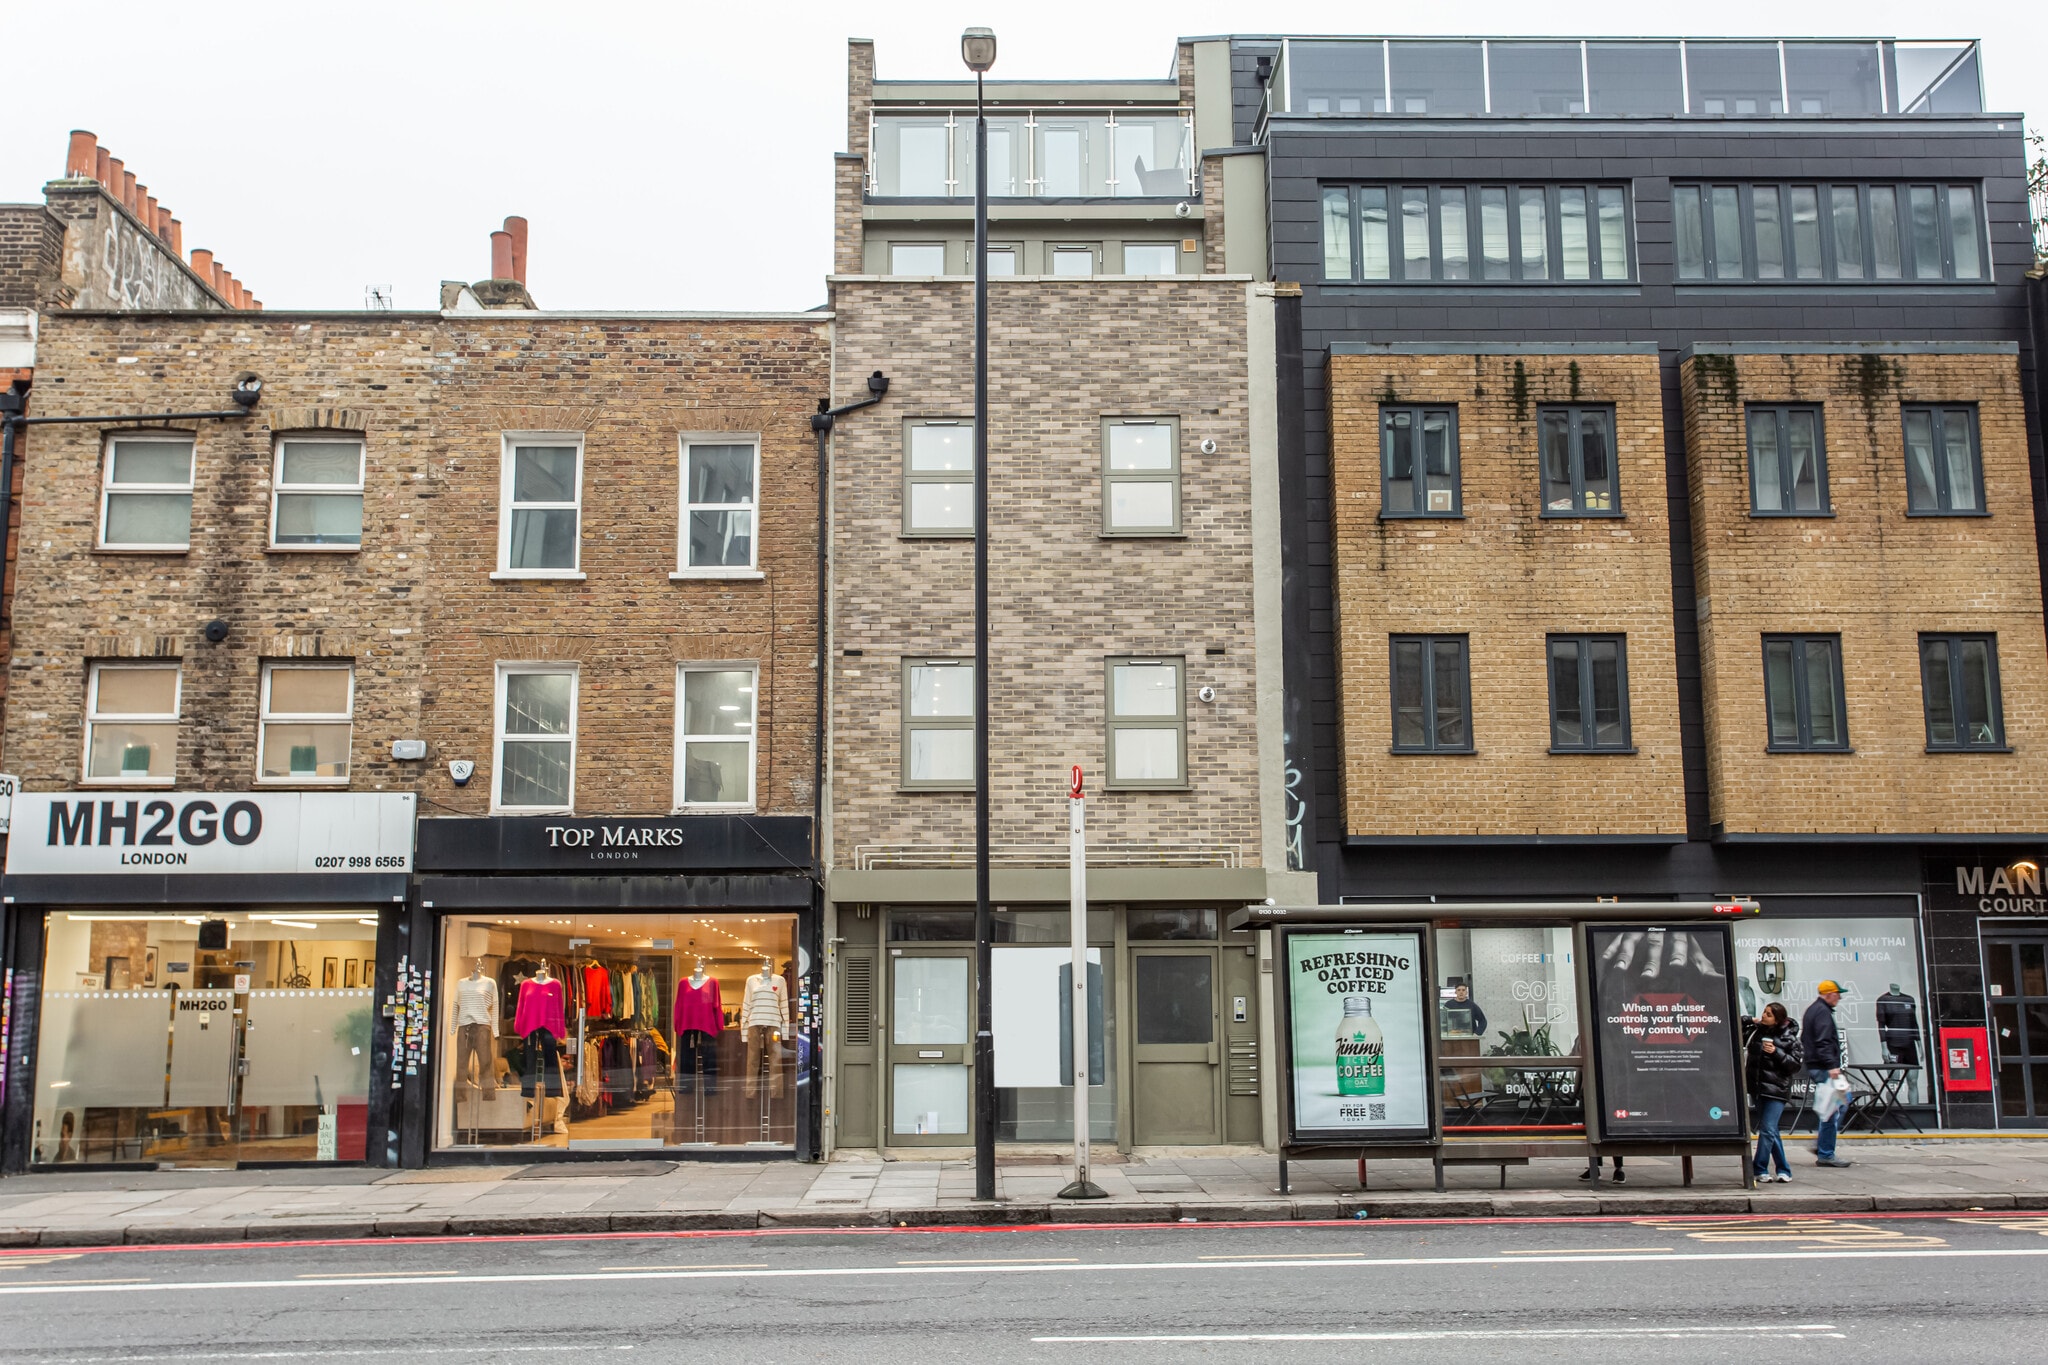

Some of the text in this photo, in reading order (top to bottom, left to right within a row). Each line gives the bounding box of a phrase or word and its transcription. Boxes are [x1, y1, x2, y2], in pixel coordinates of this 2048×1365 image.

[46, 799, 263, 847] MH2GO
[120, 852, 188, 865] LONDON
[315, 856, 405, 868] 0207 998 6565
[590, 852, 639, 860] LONDON
[1956, 866, 2048, 896] MAN
[1978, 898, 2048, 913] COURT
[1735, 937, 1906, 948] MIXED MARTIAL ARTS MUAY THAI
[1300, 952, 1410, 973] REFRESHING
[1500, 953, 1540, 963] COFFEE
[1749, 951, 1892, 963] BRAZILIAN JIU JITSU YOGA
[1318, 966, 1394, 982] OAT ICED
[1327, 980, 1387, 994] COFFEE
[1781, 980, 1863, 1001] MA
[180, 1000, 228, 1011] MH2GO
[1622, 1003, 1705, 1012] When an abuser
[1607, 1014, 1722, 1025] controls your finances,
[1623, 1025, 1708, 1036] they control you.
[1338, 1064, 1383, 1078] COFFEE
[1340, 1108, 1367, 1117] FREE
